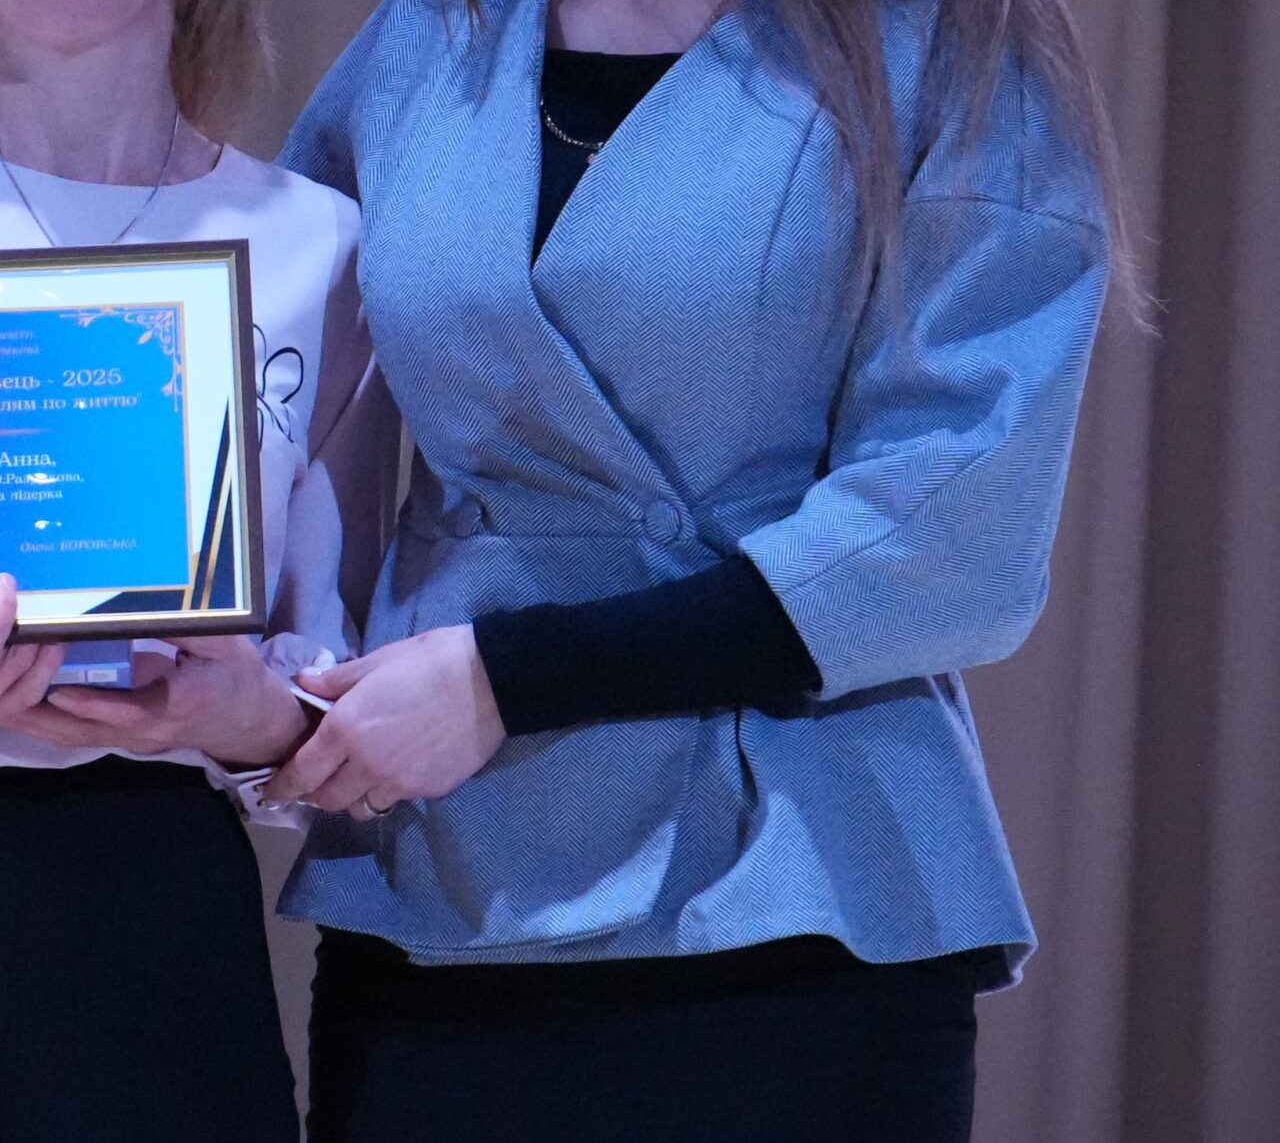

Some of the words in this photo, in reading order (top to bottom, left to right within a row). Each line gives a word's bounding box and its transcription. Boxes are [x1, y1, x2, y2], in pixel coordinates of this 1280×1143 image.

[62, 367, 122, 386] 2025
[42, 398, 66, 409] по
[10, 489, 63, 502] лідерка
